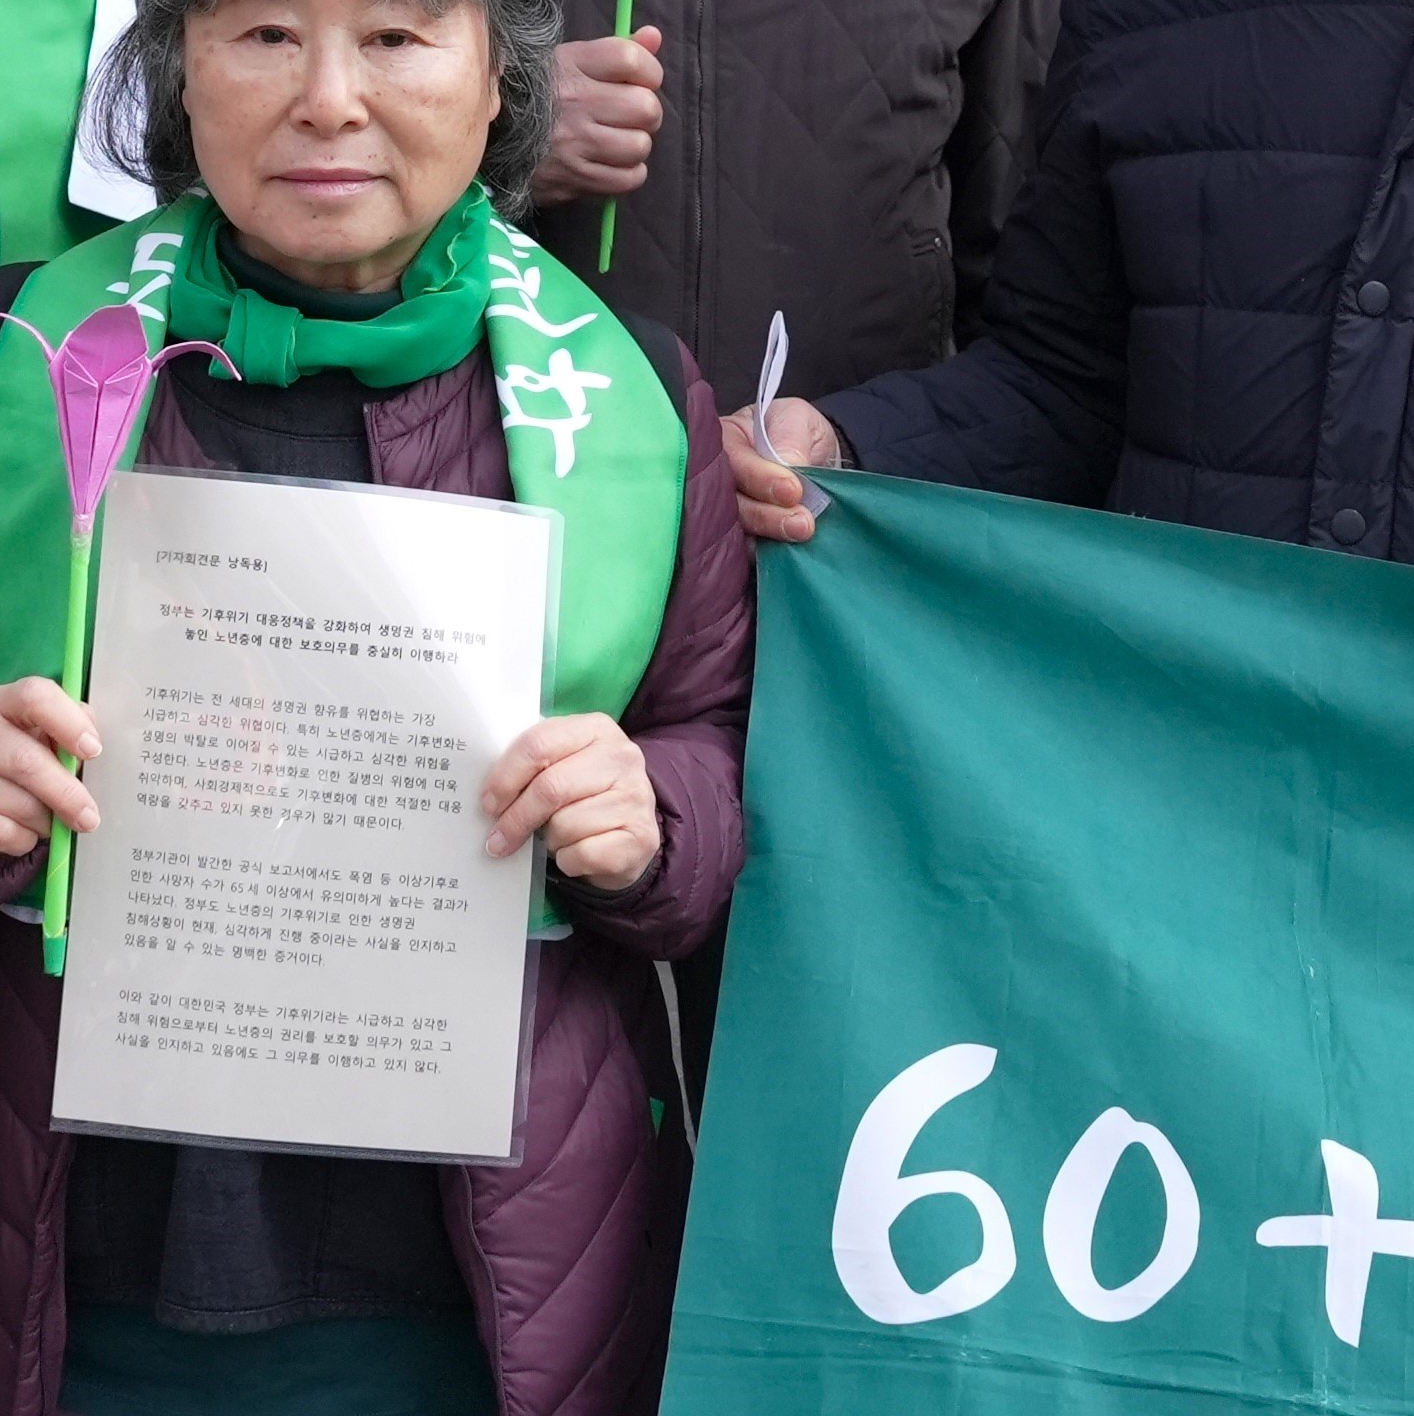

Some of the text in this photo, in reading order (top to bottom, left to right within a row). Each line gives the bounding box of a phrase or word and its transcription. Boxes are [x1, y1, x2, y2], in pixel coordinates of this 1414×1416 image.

[159, 603, 194, 619] 정부는
[201, 607, 249, 624] 기후위기
[322, 618, 371, 635] 강화하여
[378, 623, 414, 639] 생명권
[214, 631, 262, 647] 노년층에
[268, 635, 293, 650] 대한
[299, 638, 359, 656] 보호의무를
[366, 644, 403, 660] 충실히
[409, 648, 457, 663] 이행하라
[145, 686, 204, 705] 기후위기는
[211, 693, 222, 707] 전
[228, 695, 265, 711] 세대의
[271, 699, 307, 715] 생명권
[356, 707, 405, 724] 위협하는
[411, 712, 436, 727] 가장
[143, 707, 190, 723] 시급하고
[197, 713, 232, 729] 심각한
[296, 723, 320, 738] 특히
[326, 726, 400, 745] 노년층에게는
[406, 733, 467, 752] 기후변화는
[141, 729, 451, 771] 생명의 박탈로 이어질 수 있는 시급하고 심각한 위험을
[196, 757, 243, 773] 노년층은
[250, 761, 309, 779] 기후변화로
[317, 768, 341, 783] 인한
[348, 771, 384, 787] 질병의
[390, 774, 427, 790] 위험에
[136, 792, 171, 809] 역량을
[177, 796, 213, 811] 갖추고
[219, 801, 243, 816] 있지
[249, 804, 273, 819] 못한
[193, 777, 289, 798] 사회경제적으로도
[297, 788, 358, 806] 기후변화에
[363, 794, 388, 808] 대한
[394, 796, 431, 812] 적절한
[437, 799, 462, 814] 대응
[131, 847, 190, 867] 정부기관이
[197, 855, 232, 871] 발간한
[238, 859, 262, 875] 공식
[269, 864, 342, 881] 보고서에서도
[379, 872, 391, 886] 등
[398, 873, 459, 889] 이상기후로
[129, 868, 153, 884] 인한
[158, 872, 195, 889] 사망자
[200, 878, 224, 892] 수가
[265, 884, 314, 901] 이상에서
[320, 889, 382, 907] 유의미하게
[388, 894, 425, 909] 높다는
[432, 897, 469, 912] 결과가
[125, 911, 185, 931] 침해상황이
[224, 923, 272, 940] 심각하게
[279, 928, 302, 943] 진행
[309, 931, 358, 948] 중이라는
[364, 936, 401, 951] 사실을
[408, 938, 456, 954] 인지하고
[184, 896, 219, 912] 정부도
[225, 902, 274, 919] 노년층의
[280, 907, 341, 924] 기후위기로
[348, 913, 372, 928] 인한
[378, 915, 415, 930] 생명권
[123, 932, 159, 950] 있음을
[165, 937, 177, 951] 알
[183, 940, 195, 953] 수
[201, 941, 225, 957] 있는
[231, 944, 267, 961] 명백한
[118, 989, 448, 1032] 이와 같이 대한민국 정부는 기후위기라는 시급하고 심각한
[117, 1010, 452, 1052] 침해 위험으로부터 노년층의 권리를 보호할 의무가 있고 그
[114, 1032, 150, 1048] 사실을
[157, 1036, 204, 1053] 인지하고
[211, 1042, 259, 1059] 있음에도
[265, 1049, 277, 1060] 그
[284, 1050, 320, 1065] 의무를
[327, 1053, 376, 1069] 이행하고
[383, 1057, 407, 1072] 있지
